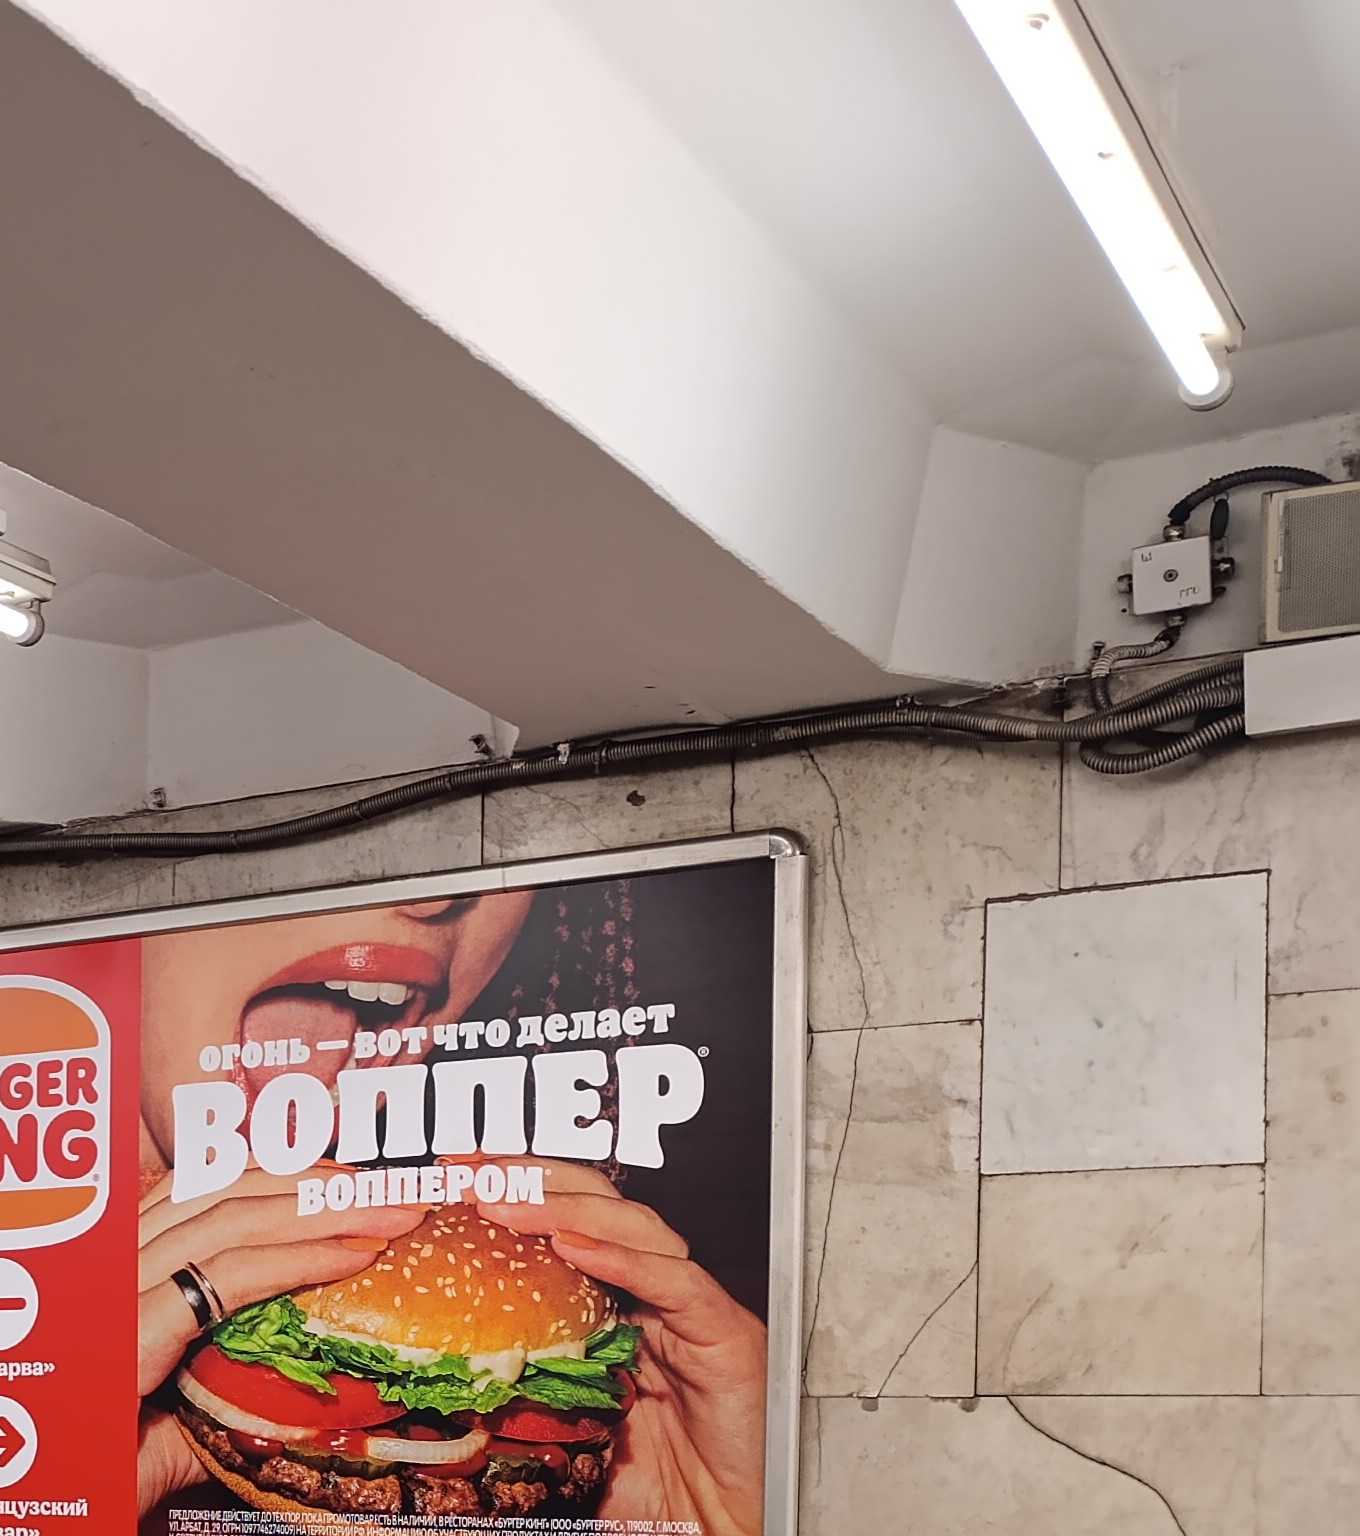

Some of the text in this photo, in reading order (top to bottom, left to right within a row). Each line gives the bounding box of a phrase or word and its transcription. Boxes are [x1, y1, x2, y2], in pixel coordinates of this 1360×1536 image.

[198, 1037, 310, 1073] огонь
[353, 1025, 428, 1060] вот
[432, 1018, 512, 1052] что
[514, 1003, 676, 1047] делает
[171, 1043, 705, 1204] ВОППЕР
[296, 1164, 545, 1217] ВОППЕРОМ
[169, 1509, 221, 1520] ПРЕДЛОЖЕНИЕ
[444, 1515, 494, 1528] РЕСТОРАНАХ
